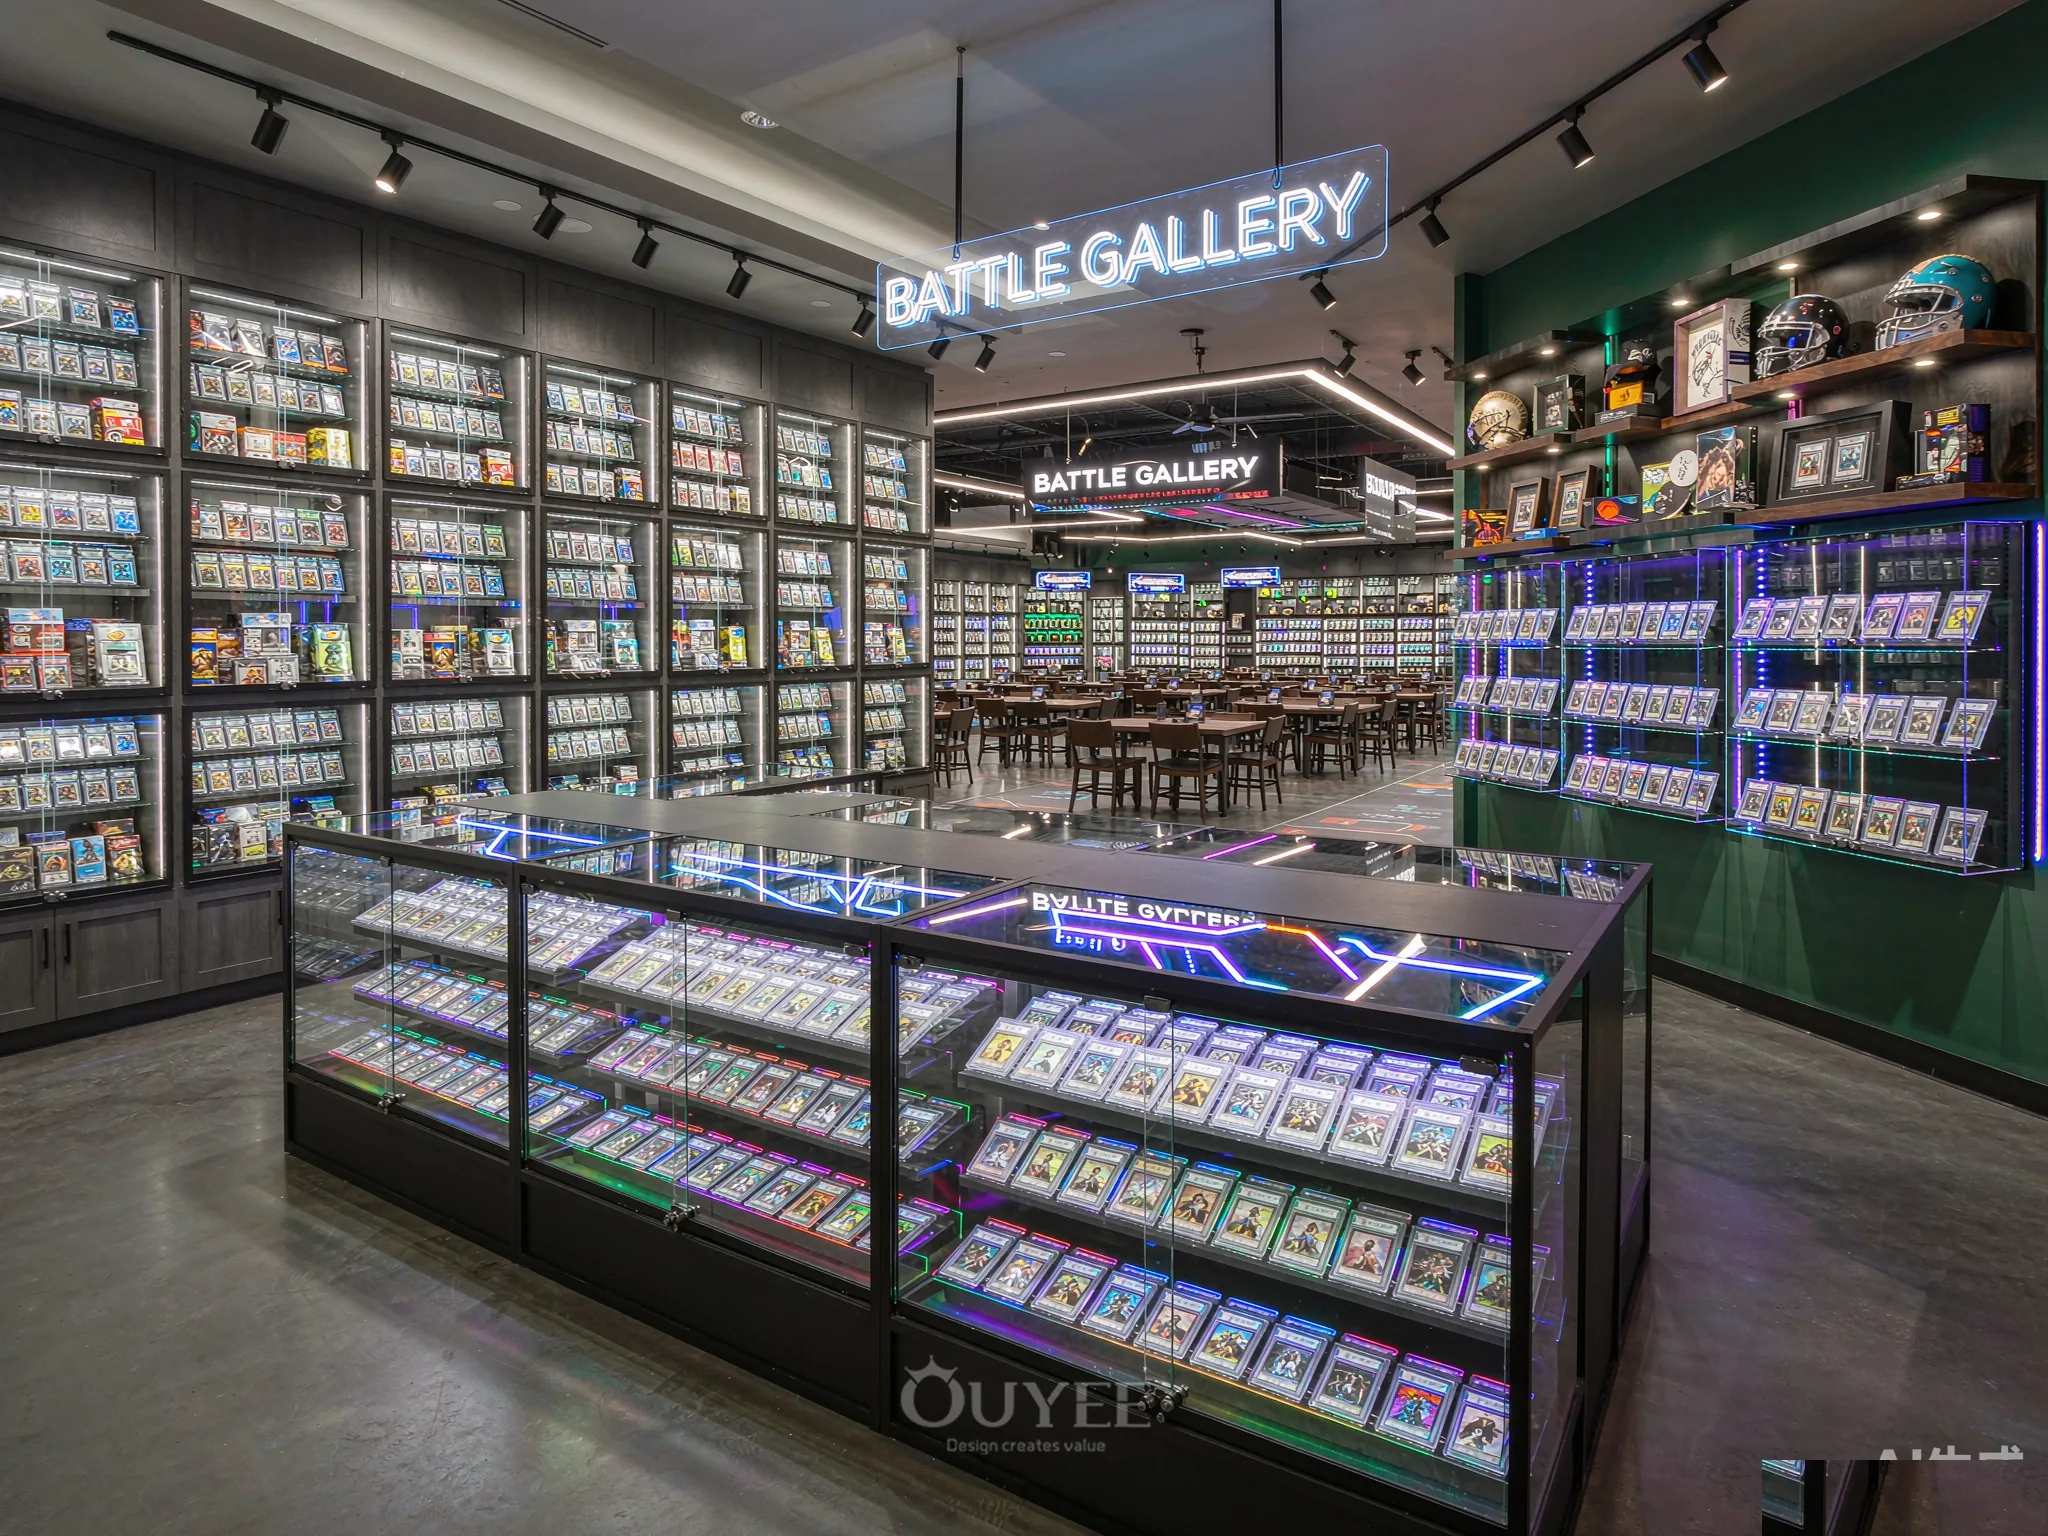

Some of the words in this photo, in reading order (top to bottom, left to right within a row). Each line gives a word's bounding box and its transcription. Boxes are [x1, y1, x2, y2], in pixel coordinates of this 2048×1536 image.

[885, 240, 1071, 328] BATTLE
[1080, 171, 1371, 288] GALLERY
[1033, 467, 1127, 495] BATTLE
[1135, 455, 1260, 486] GALLERY
